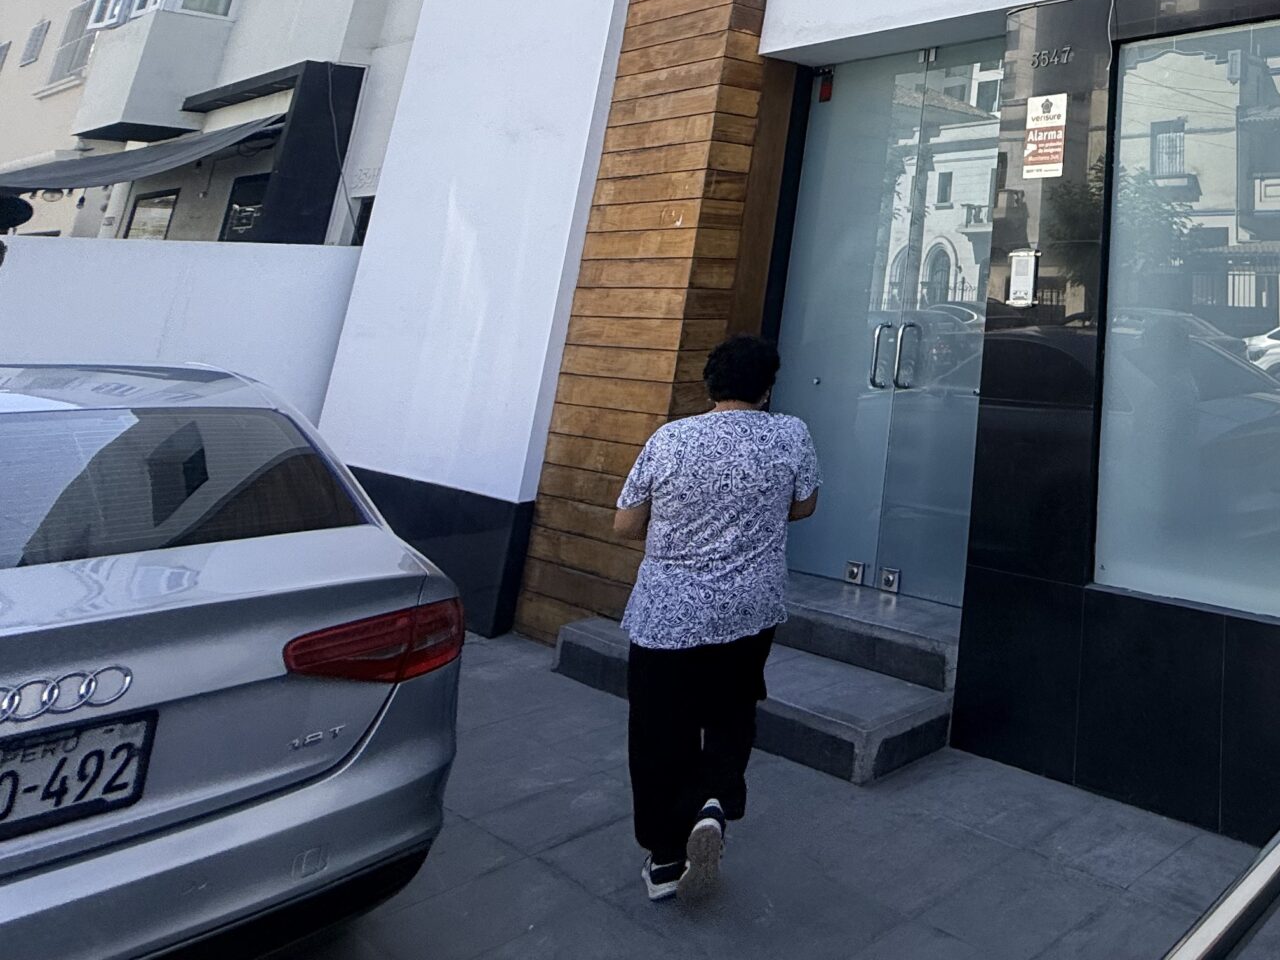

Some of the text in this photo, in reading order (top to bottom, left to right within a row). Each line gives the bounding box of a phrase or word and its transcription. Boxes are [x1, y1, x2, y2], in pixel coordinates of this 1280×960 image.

[1031, 46, 1072, 69] 3547
[1031, 113, 1062, 122] verisure
[1027, 129, 1063, 142] Alarma
